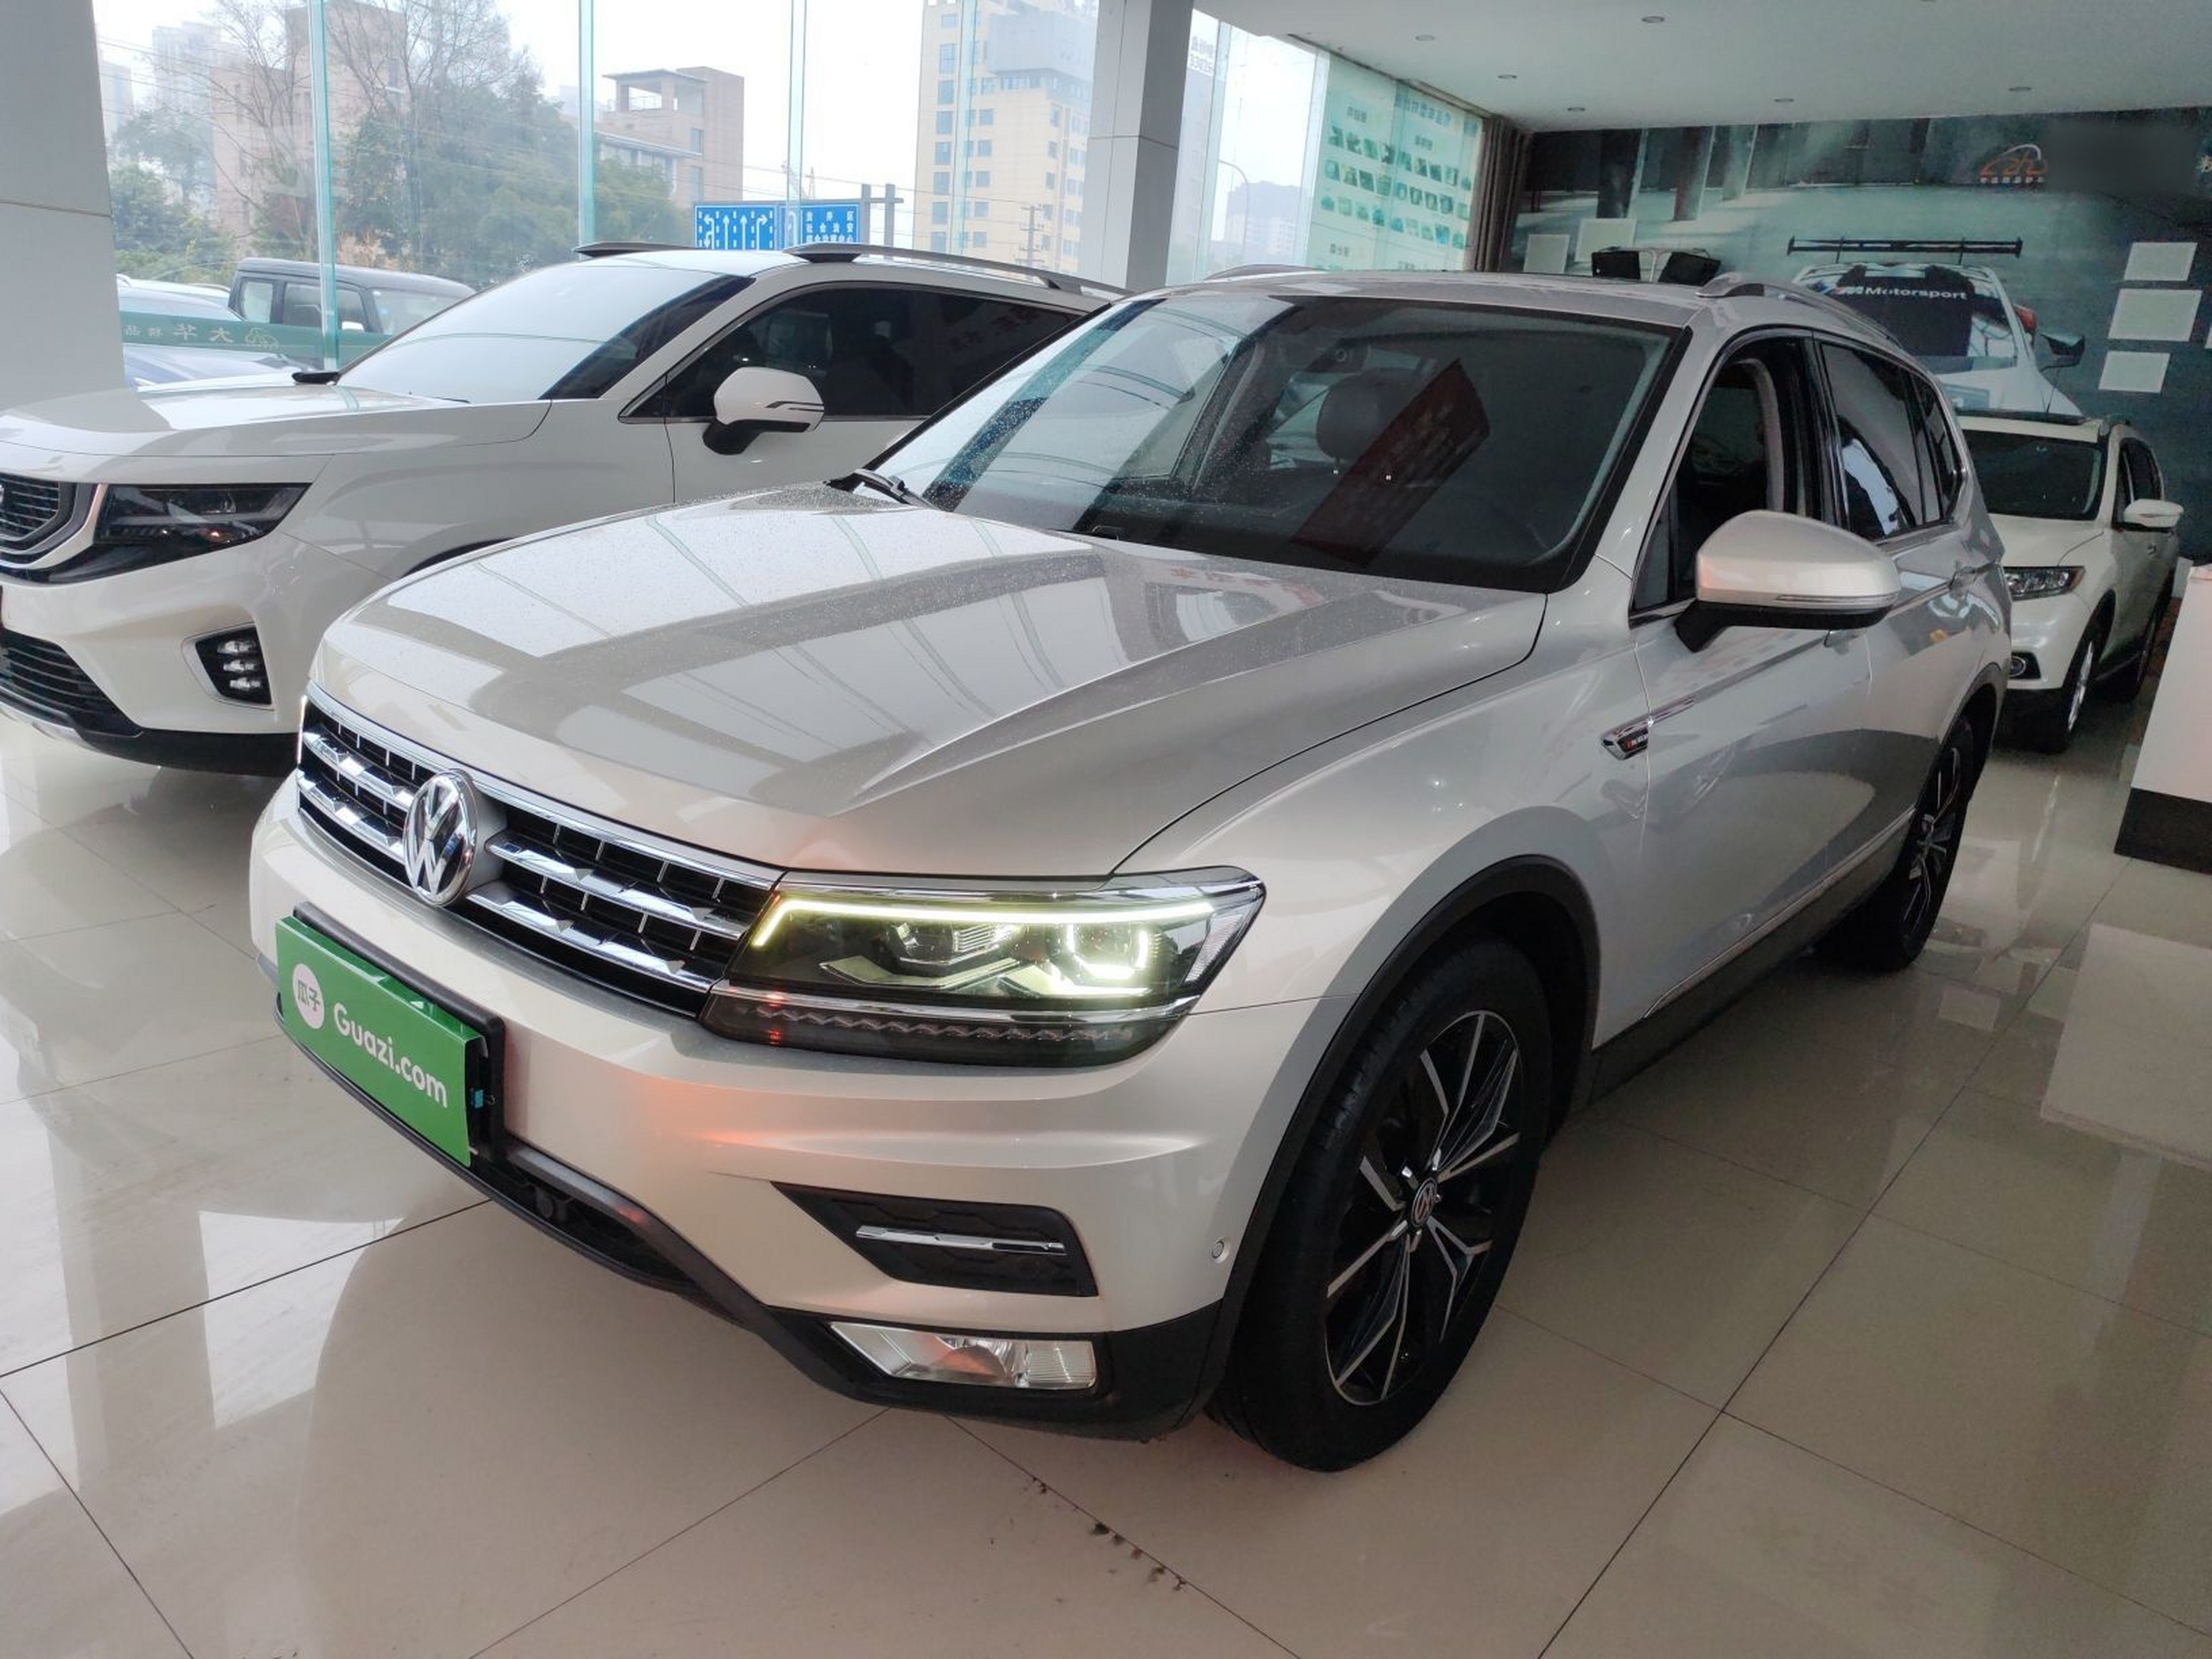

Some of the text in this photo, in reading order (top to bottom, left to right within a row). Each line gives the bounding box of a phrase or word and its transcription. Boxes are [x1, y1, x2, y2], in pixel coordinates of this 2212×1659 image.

[1865, 287, 1967, 300] Motorsport
[297, 979, 448, 1108] 瓜子 Guazi.com
